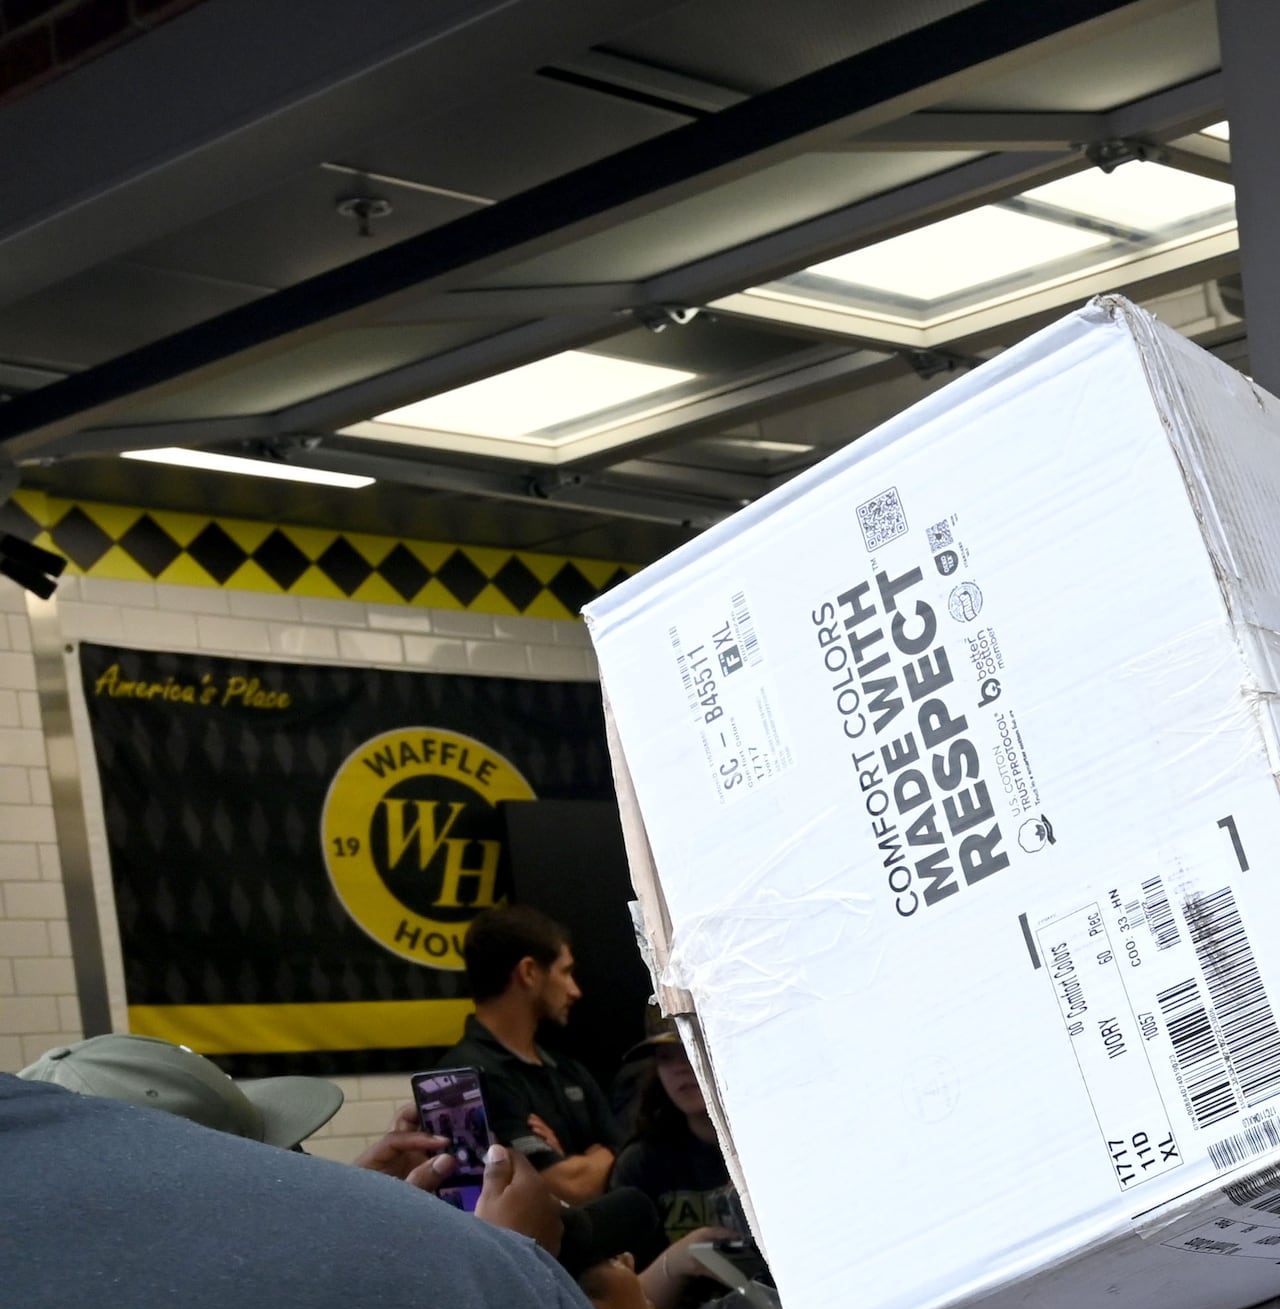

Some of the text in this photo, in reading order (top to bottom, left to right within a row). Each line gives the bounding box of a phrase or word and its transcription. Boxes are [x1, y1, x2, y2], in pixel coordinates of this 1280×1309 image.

[712, 620, 734, 650] XL
[978, 629, 998, 675] cotton
[986, 626, 1005, 670] member
[968, 636, 986, 682] better
[96, 664, 291, 709] America's Place
[687, 645, 724, 725] B45511
[837, 580, 960, 907] MADE WITH
[875, 566, 1010, 886] RESPECT
[362, 738, 497, 786] WAFFLE
[719, 758, 744, 791] SC
[748, 746, 765, 780] 1717
[812, 601, 919, 917] COMFORT COLORS
[993, 745, 1014, 793] COTTON
[1013, 779, 1032, 812] TRUST
[332, 837, 361, 858] 19
[376, 797, 502, 908] WH
[1050, 939, 1076, 980] Colors
[1122, 934, 1143, 968] COO:
[1058, 974, 1088, 1020] Comfort
[1083, 910, 1179, 1162] XL 60 Piec
[1136, 1008, 1160, 1042] 10057
[1096, 1013, 1157, 1172] 11D IVORY
[1107, 1134, 1137, 1187] 1717
